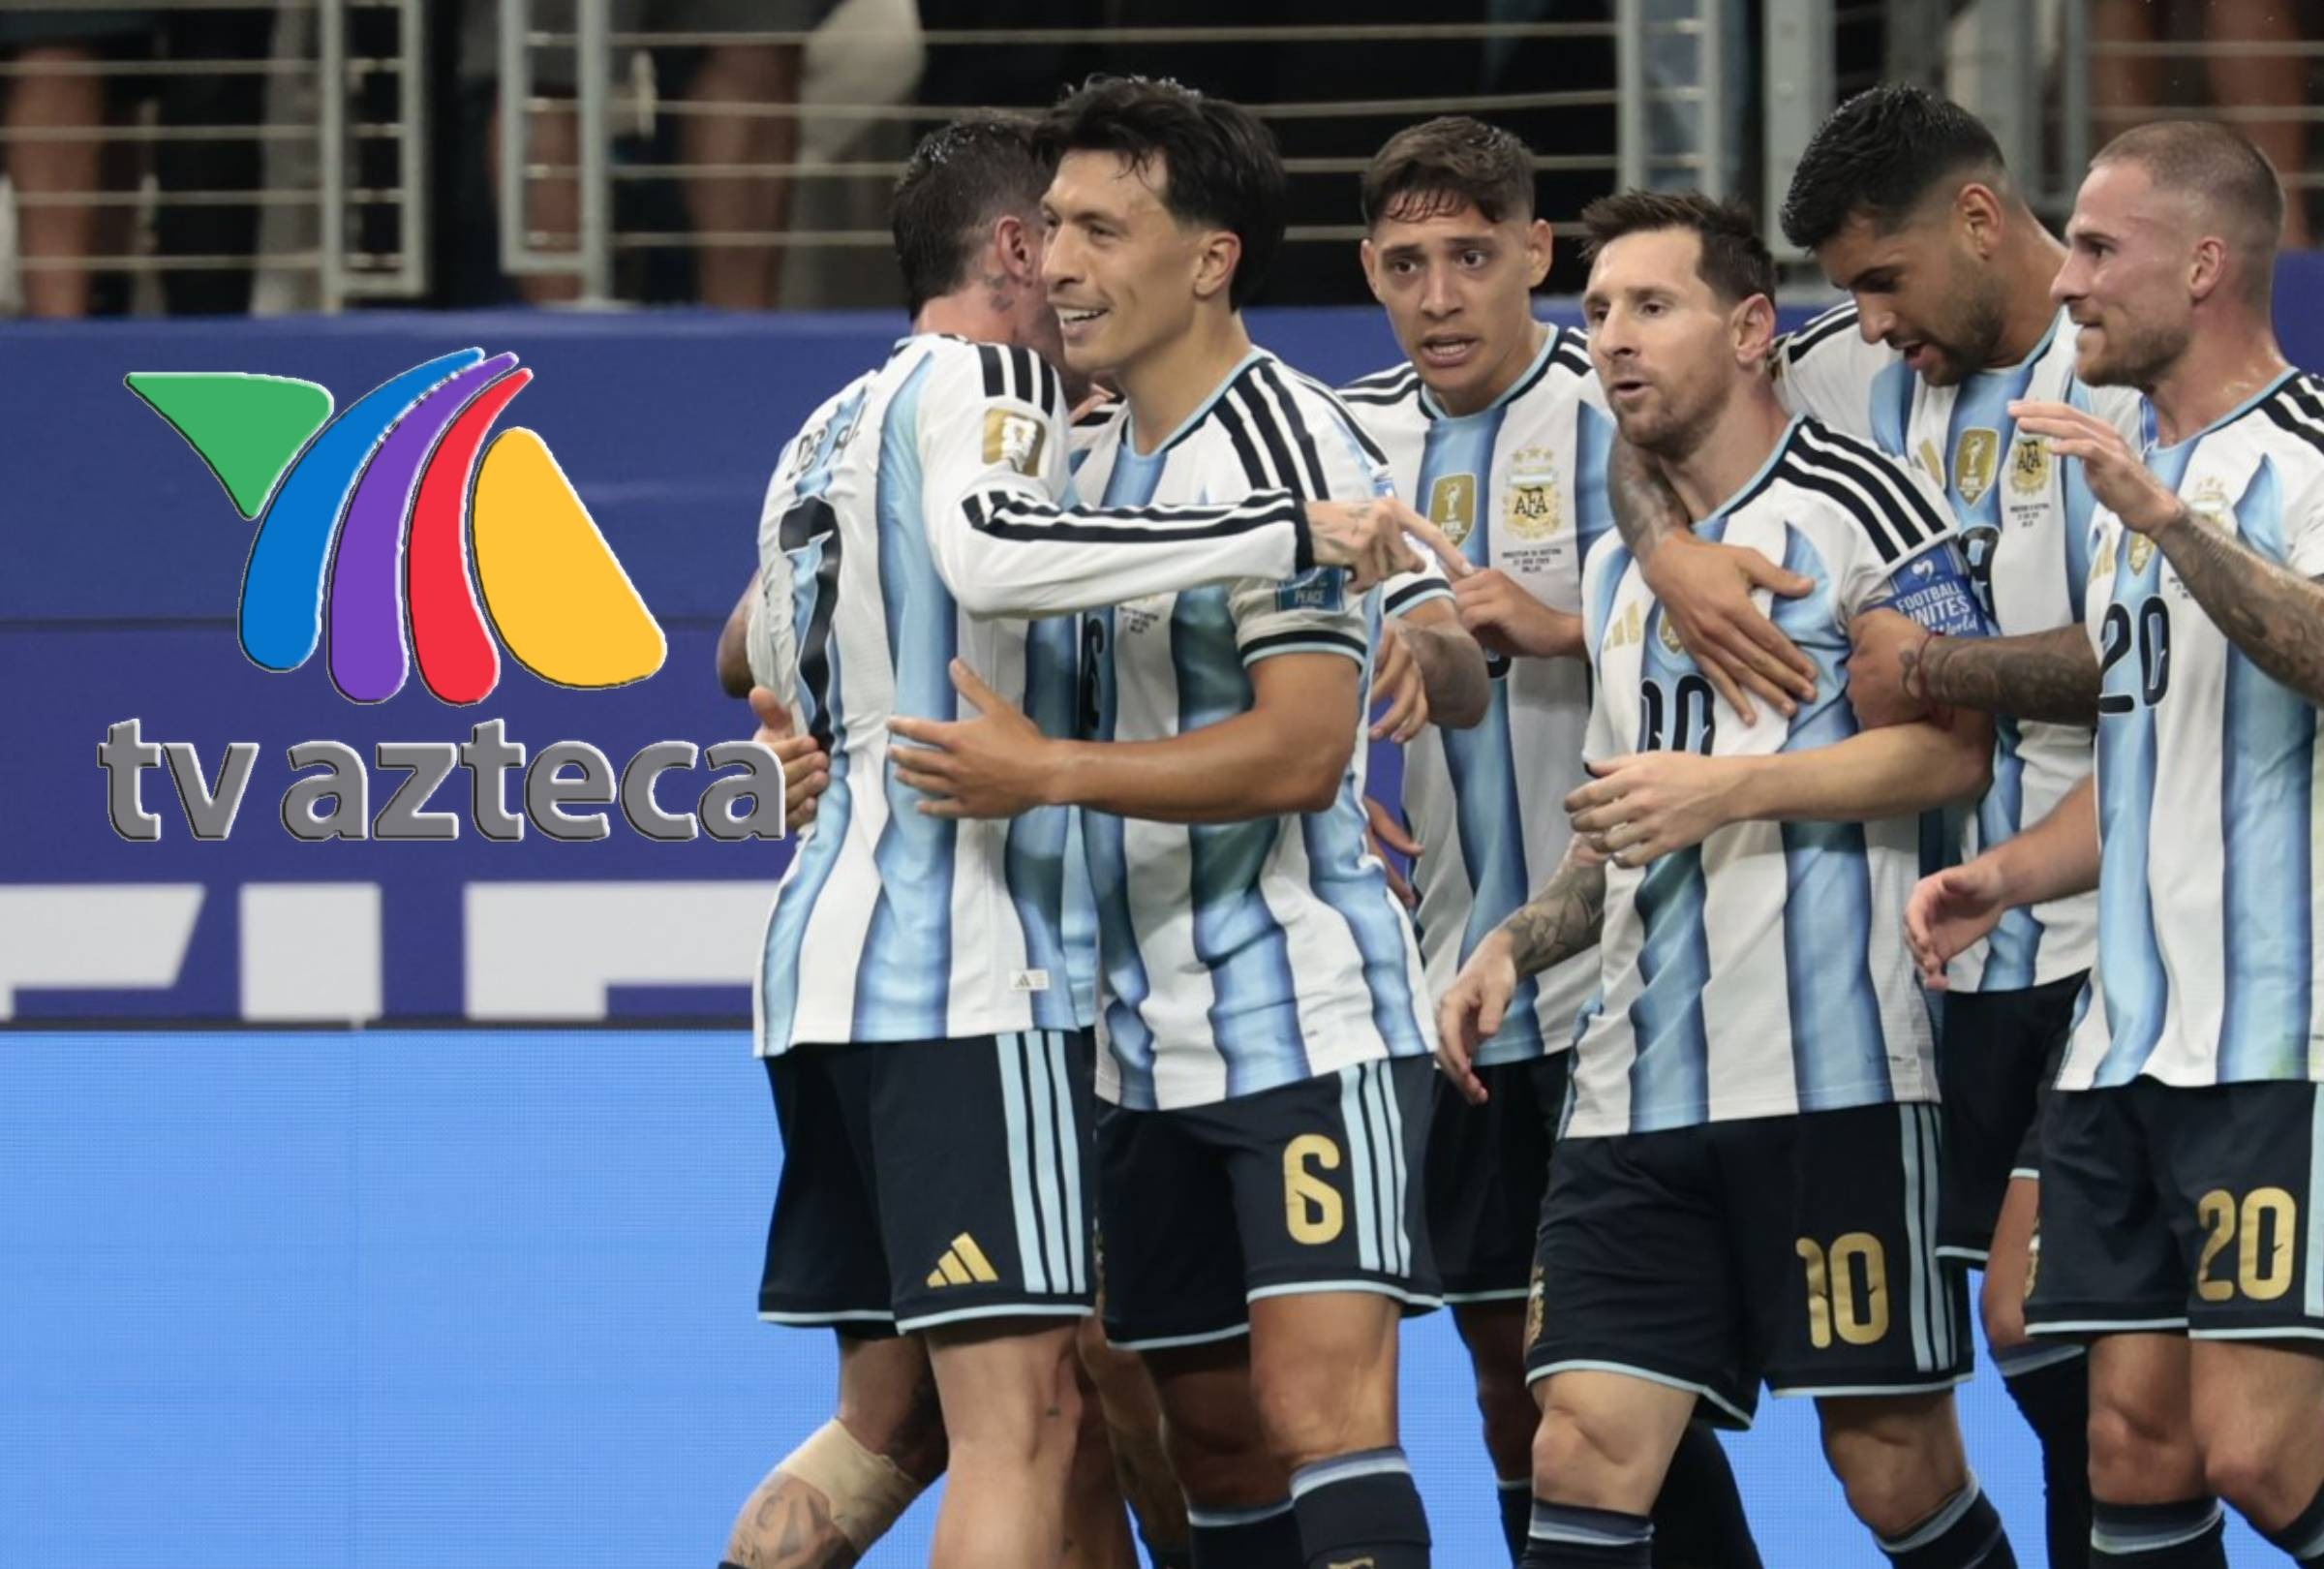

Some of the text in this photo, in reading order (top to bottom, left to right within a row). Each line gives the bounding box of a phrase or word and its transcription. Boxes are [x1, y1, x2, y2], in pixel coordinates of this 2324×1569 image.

[1514, 485, 1549, 519] AFA
[1895, 580, 1964, 614] FOOTBALL
[2100, 596, 2170, 715] 20
[1283, 1133, 1343, 1245] 6
[2197, 1186, 2296, 1301] 20
[1795, 1232, 1889, 1348] 10
